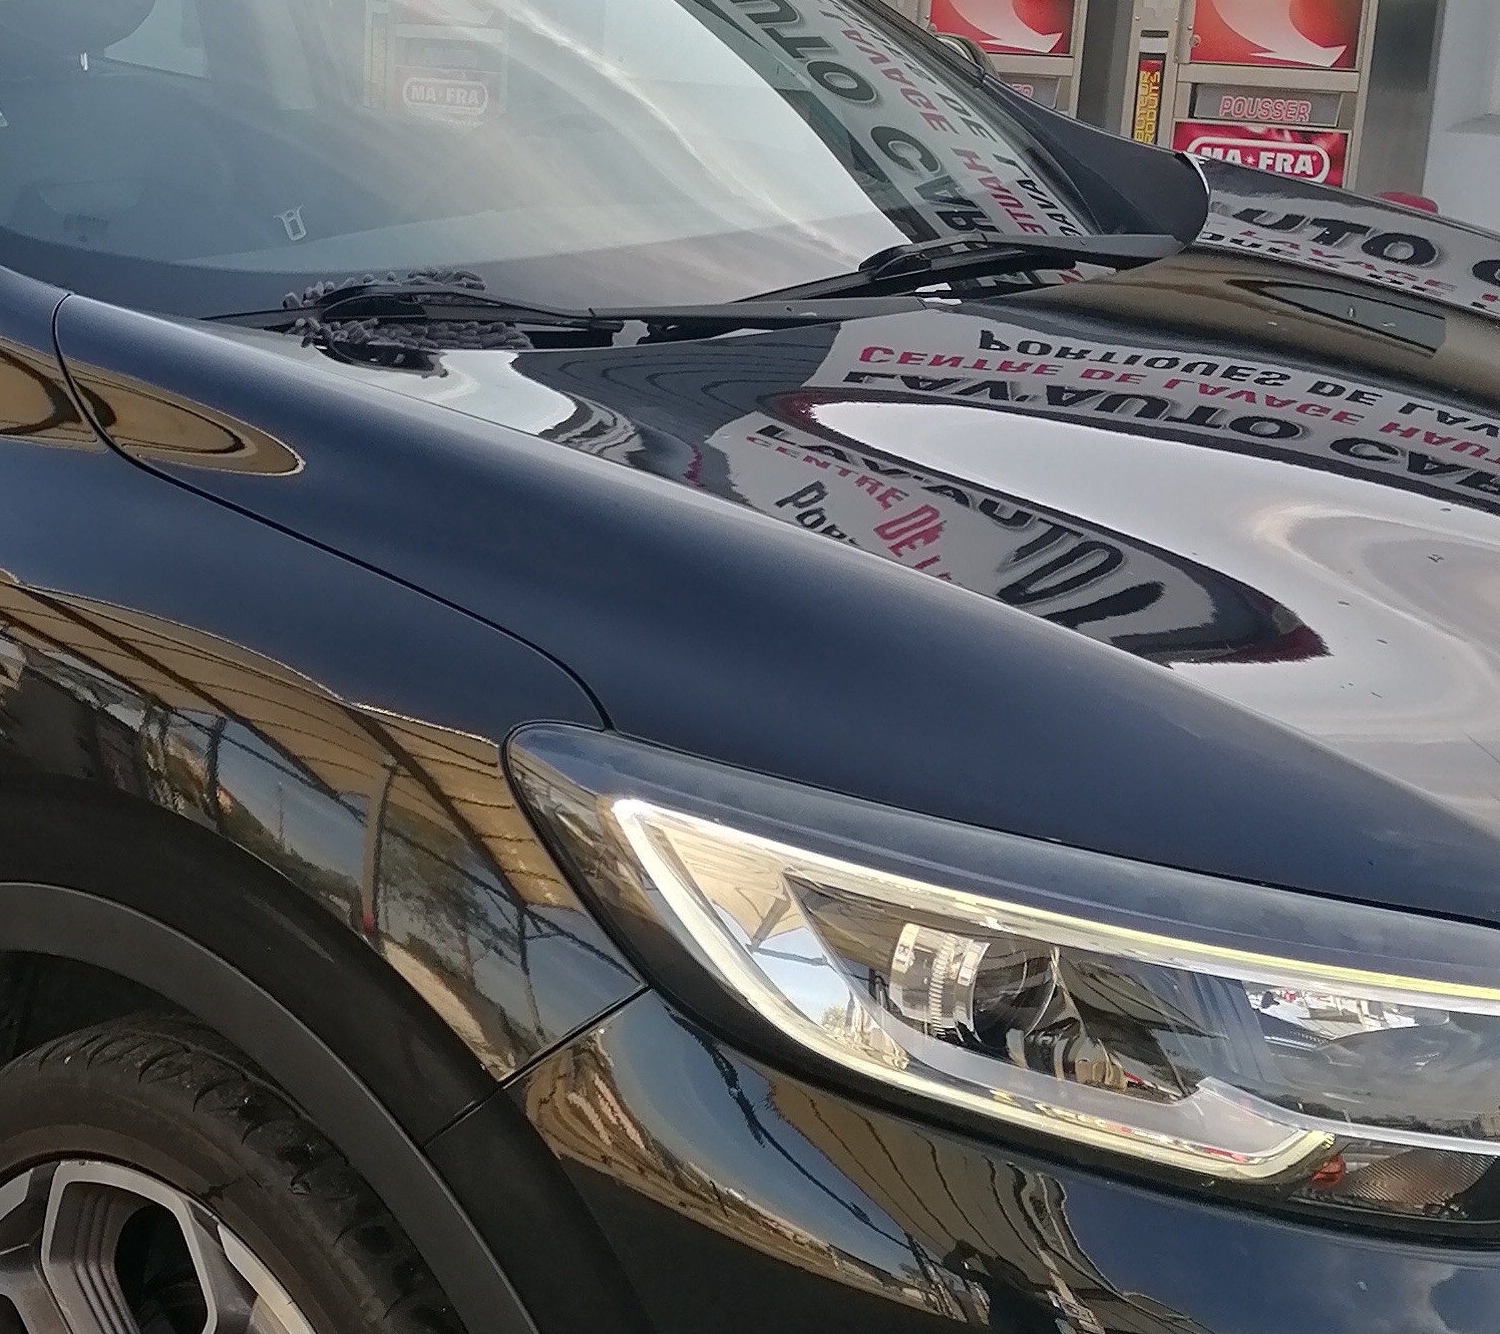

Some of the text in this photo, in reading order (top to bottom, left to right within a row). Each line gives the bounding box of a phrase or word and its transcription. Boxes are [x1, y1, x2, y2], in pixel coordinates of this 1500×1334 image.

[1134, 71, 1150, 142] BUTEUR
[1144, 71, 1161, 144] RODUITS
[1220, 95, 1312, 122] POUSSER
